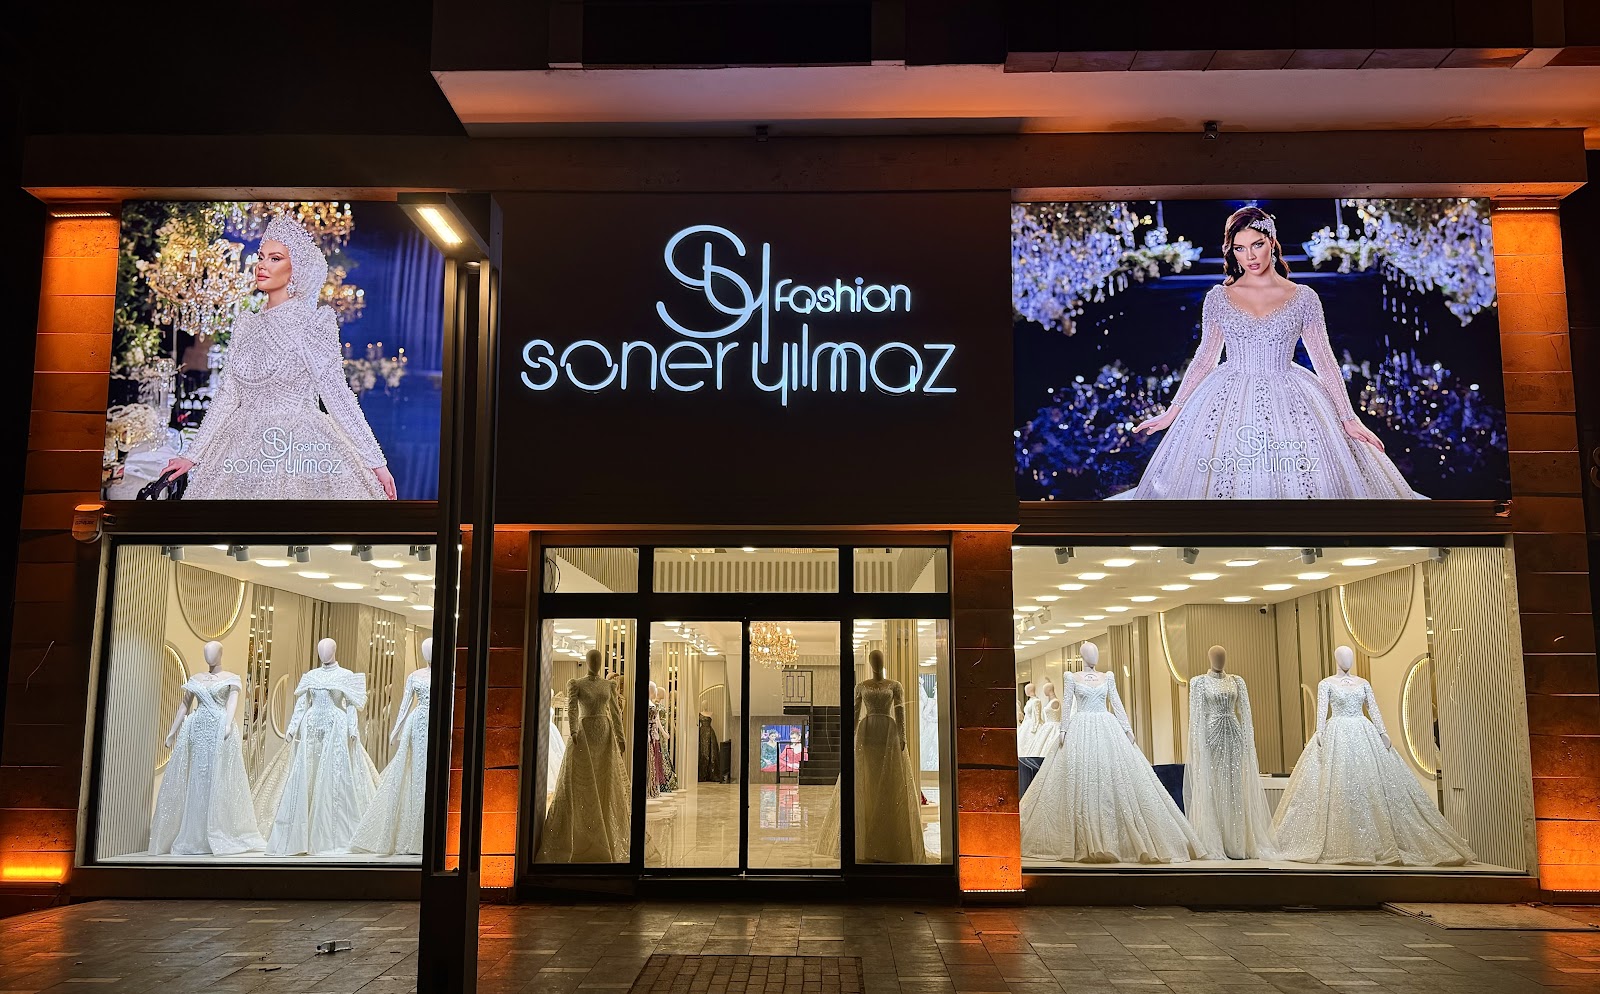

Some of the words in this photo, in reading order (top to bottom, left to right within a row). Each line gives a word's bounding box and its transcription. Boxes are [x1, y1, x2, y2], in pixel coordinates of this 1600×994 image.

[775, 277, 911, 313] fashion
[521, 339, 739, 391] soner
[293, 441, 331, 451] fashion
[1268, 440, 1307, 450] fashion
[223, 458, 283, 474] soner
[1197, 457, 1260, 472] soner
